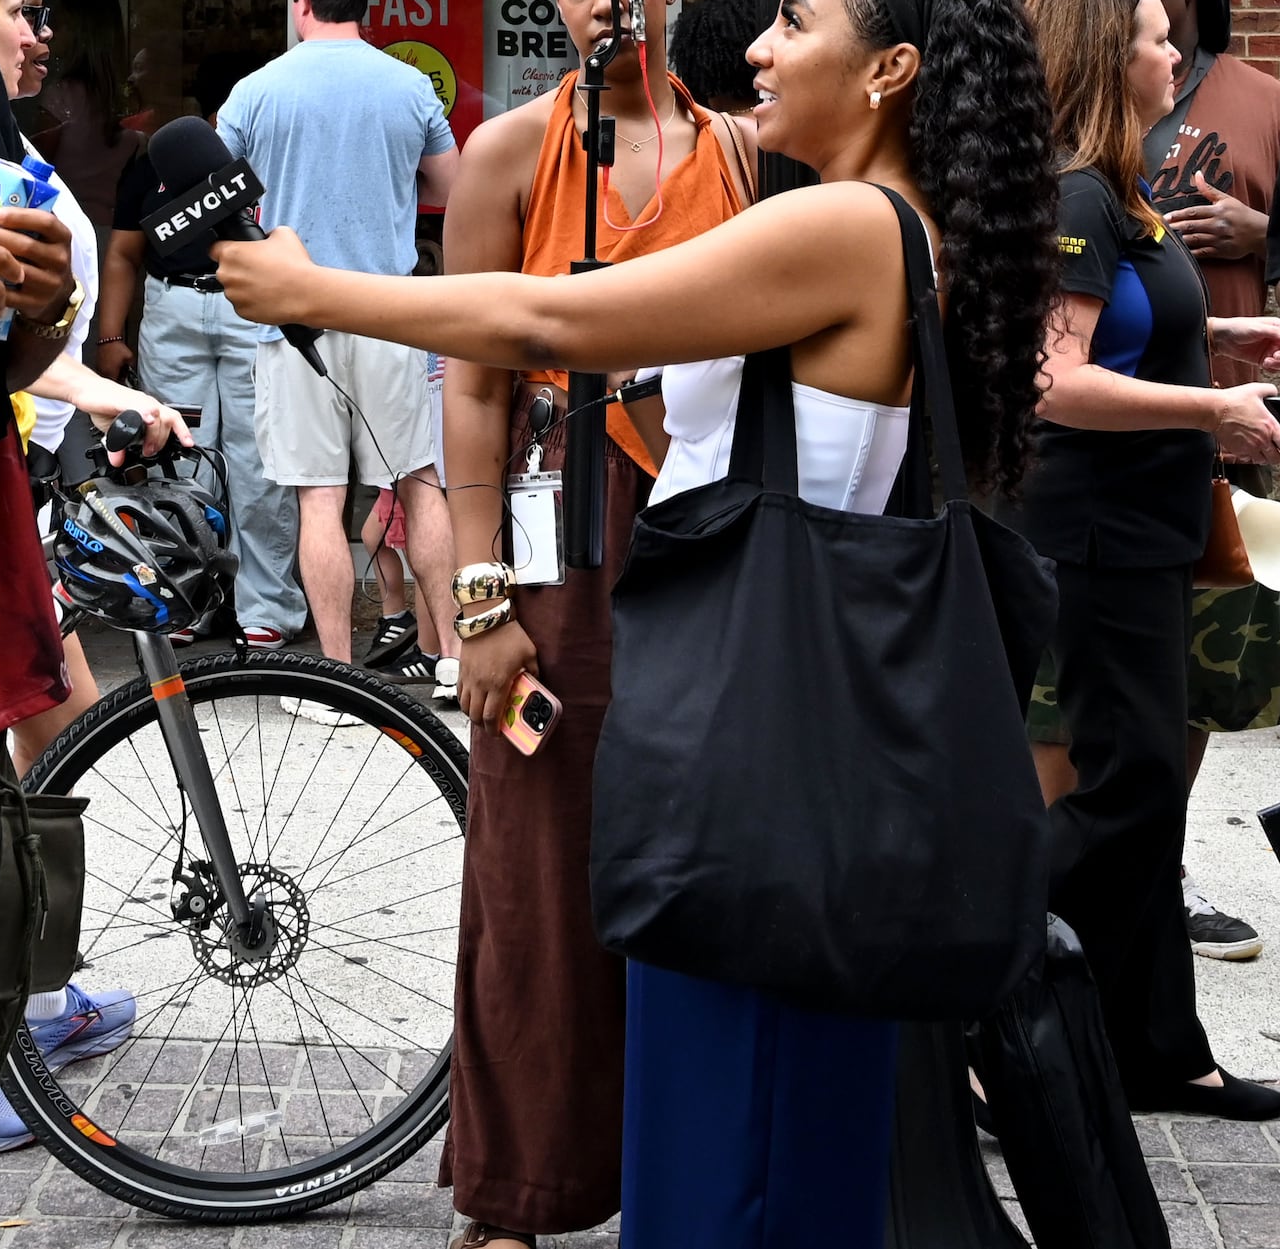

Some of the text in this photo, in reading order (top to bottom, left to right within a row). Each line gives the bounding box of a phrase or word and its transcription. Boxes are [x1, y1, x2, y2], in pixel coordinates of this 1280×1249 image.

[497, 29, 579, 58] BRE
[522, 67, 555, 81] Classic
[511, 84, 531, 96] with
[1179, 123, 1201, 138] USA
[153, 172, 247, 242] REVOLT
[275, 1164, 352, 1197] KENDA
